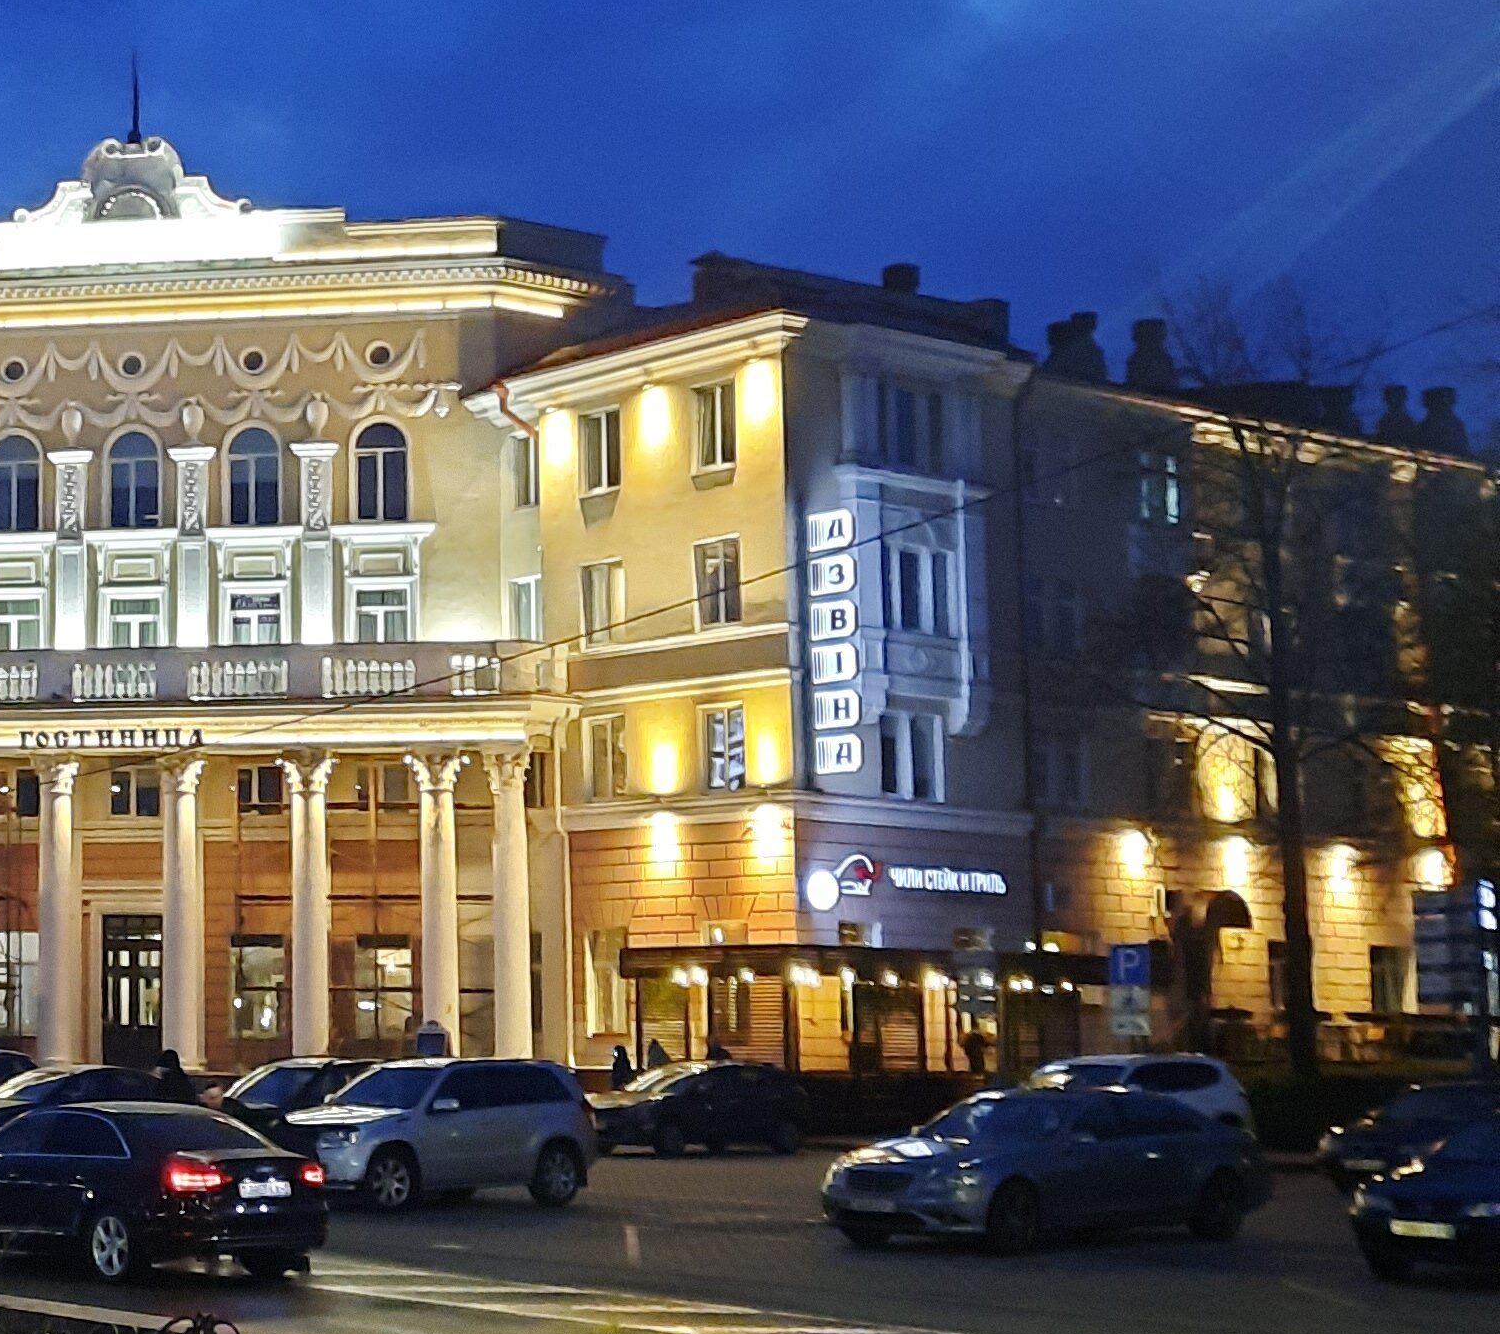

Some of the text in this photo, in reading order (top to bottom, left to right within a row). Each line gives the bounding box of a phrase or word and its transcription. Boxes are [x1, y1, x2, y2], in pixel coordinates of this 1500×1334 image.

[826, 518, 853, 765] ДЗВІНА
[18, 728, 205, 750] ГОСТИНИЦА
[888, 867, 924, 888] ЧИЛИ
[970, 871, 1007, 895] ГРИЛЬ
[1119, 949, 1140, 981] P
